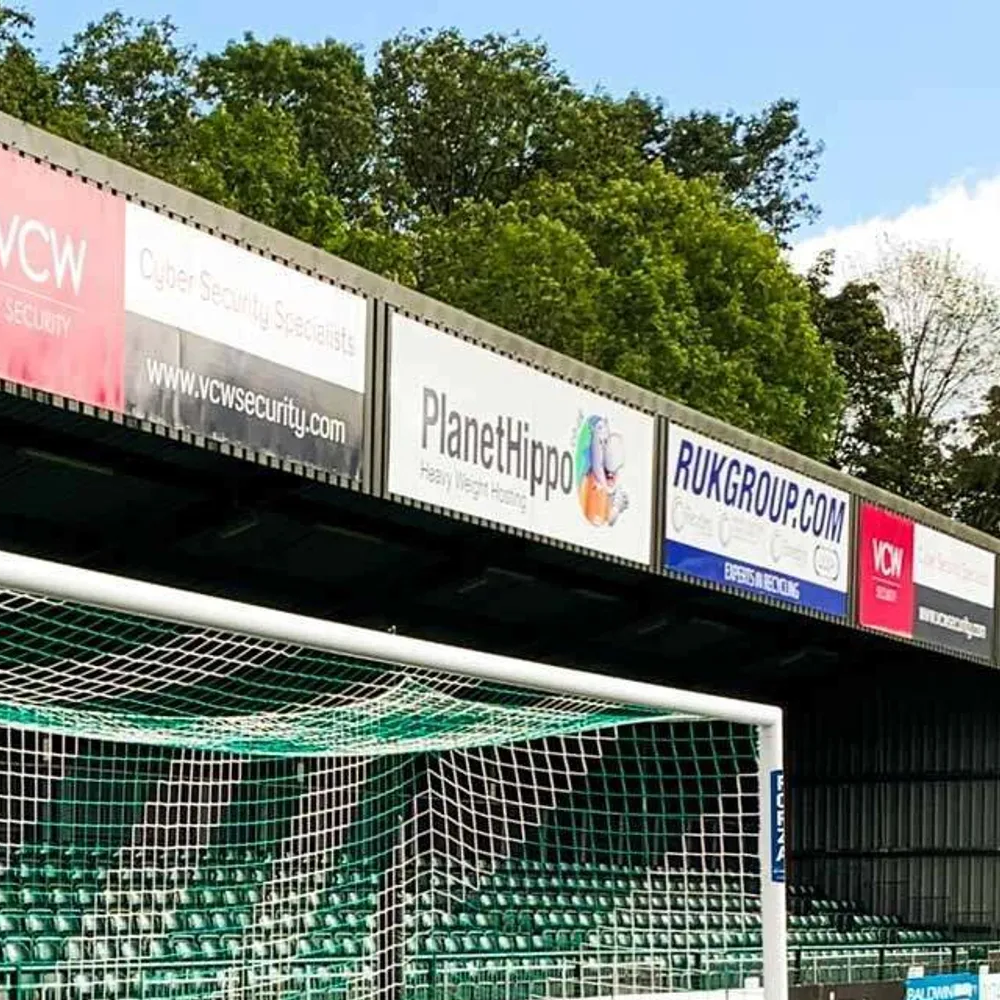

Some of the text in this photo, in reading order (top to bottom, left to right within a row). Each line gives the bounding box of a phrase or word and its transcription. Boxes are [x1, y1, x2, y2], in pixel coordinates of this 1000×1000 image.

[3, 298, 72, 339] SECURITY
[138, 247, 357, 357] Cyber Security Specialists
[146, 358, 346, 444] www.vcwsecurity.com
[421, 386, 574, 501] PlanetHippo
[673, 439, 847, 545] RUKGROUP.COM
[871, 537, 904, 578] VCW
